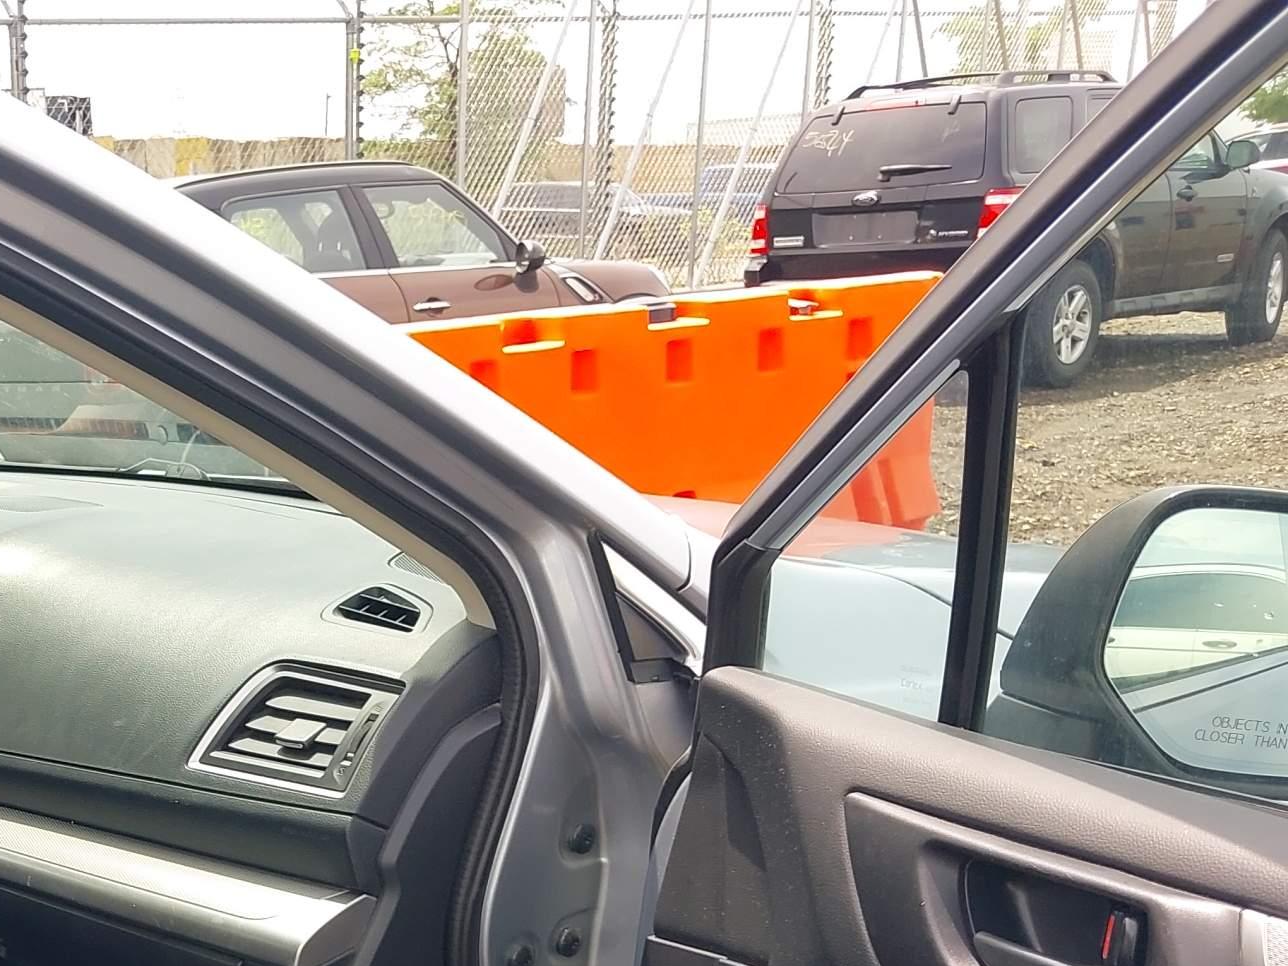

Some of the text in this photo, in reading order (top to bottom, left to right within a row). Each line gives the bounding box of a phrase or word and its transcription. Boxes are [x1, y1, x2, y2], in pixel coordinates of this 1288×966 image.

[1212, 716, 1271, 733] OBJECTS
[1194, 728, 1288, 750] CLOSER THAN
